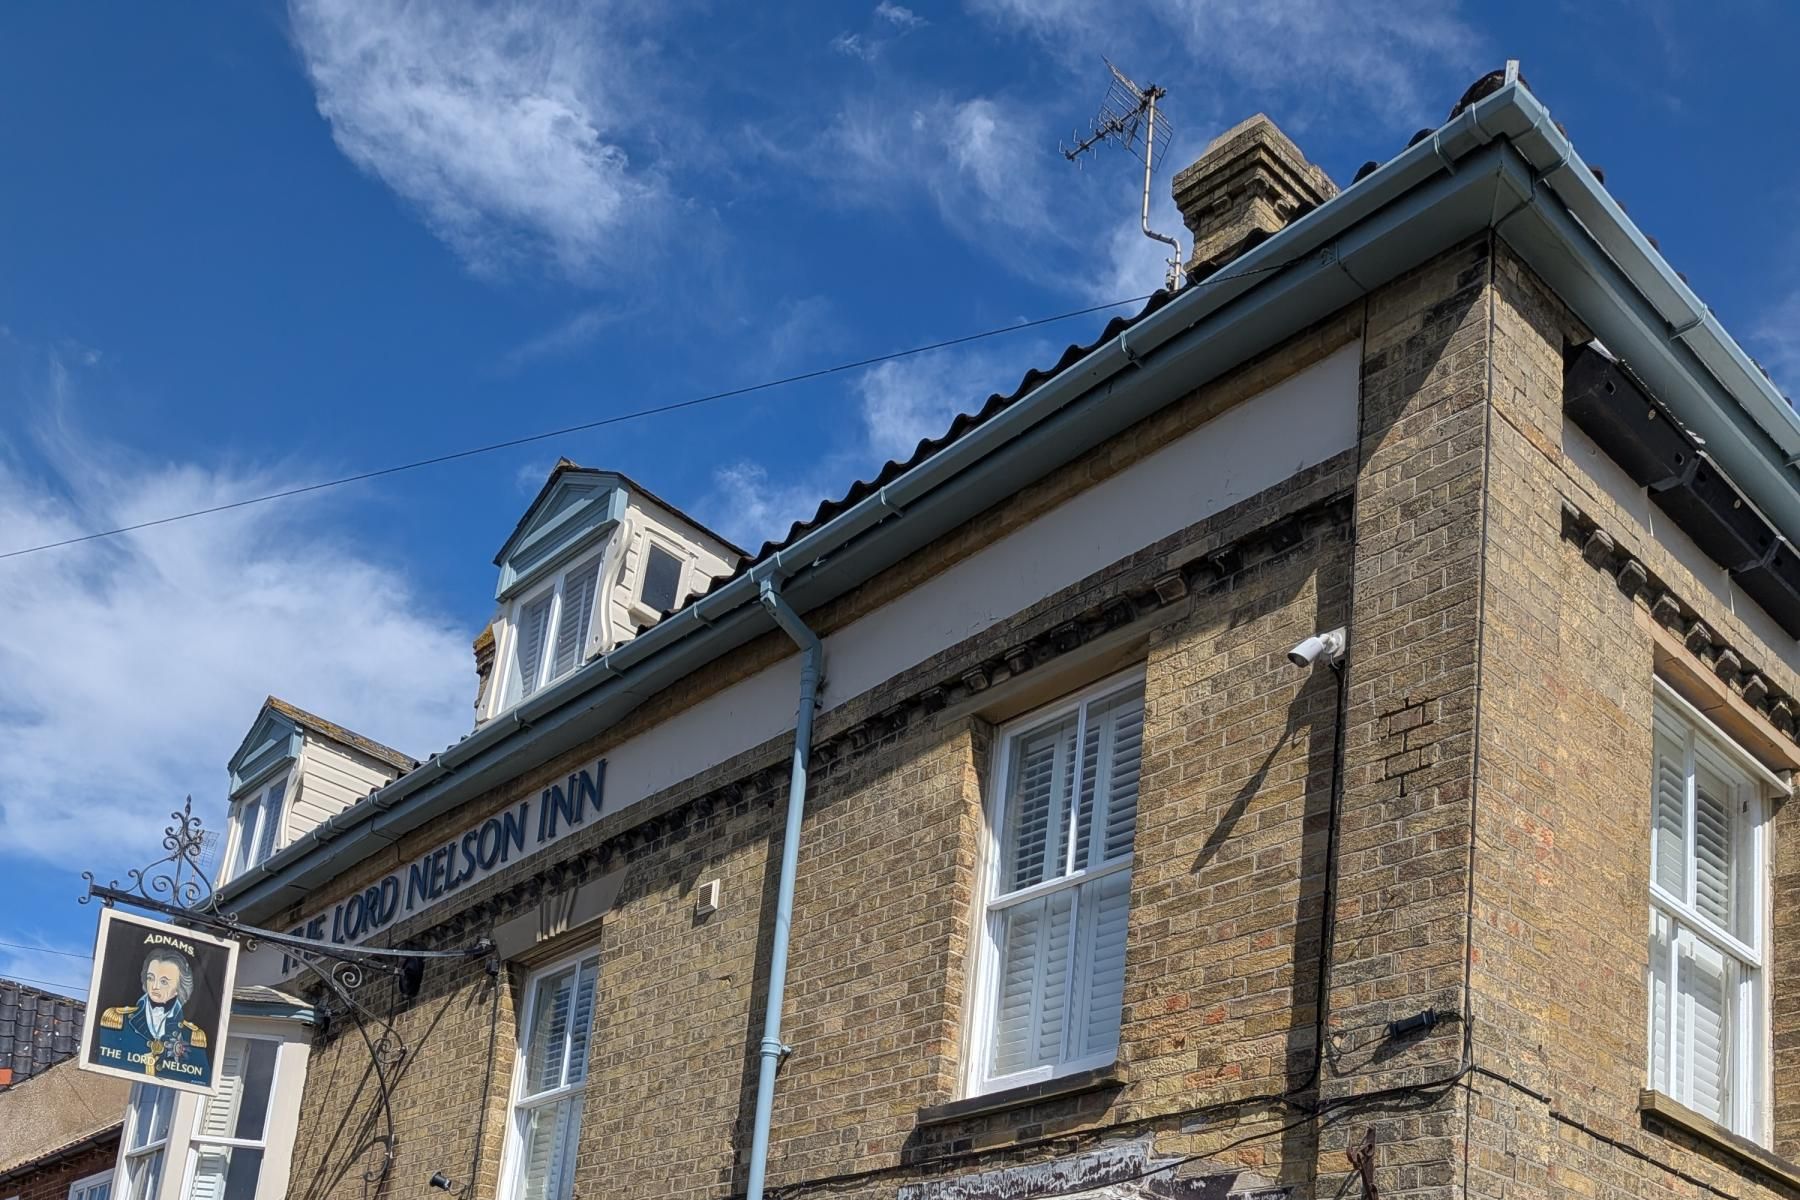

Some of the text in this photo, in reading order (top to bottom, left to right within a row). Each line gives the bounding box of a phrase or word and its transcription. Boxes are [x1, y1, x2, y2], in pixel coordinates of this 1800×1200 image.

[331, 876, 400, 945] LORD
[405, 802, 529, 911] NELSON
[537, 758, 608, 844] INN
[100, 1046, 203, 1077] THE LORD NELSON
